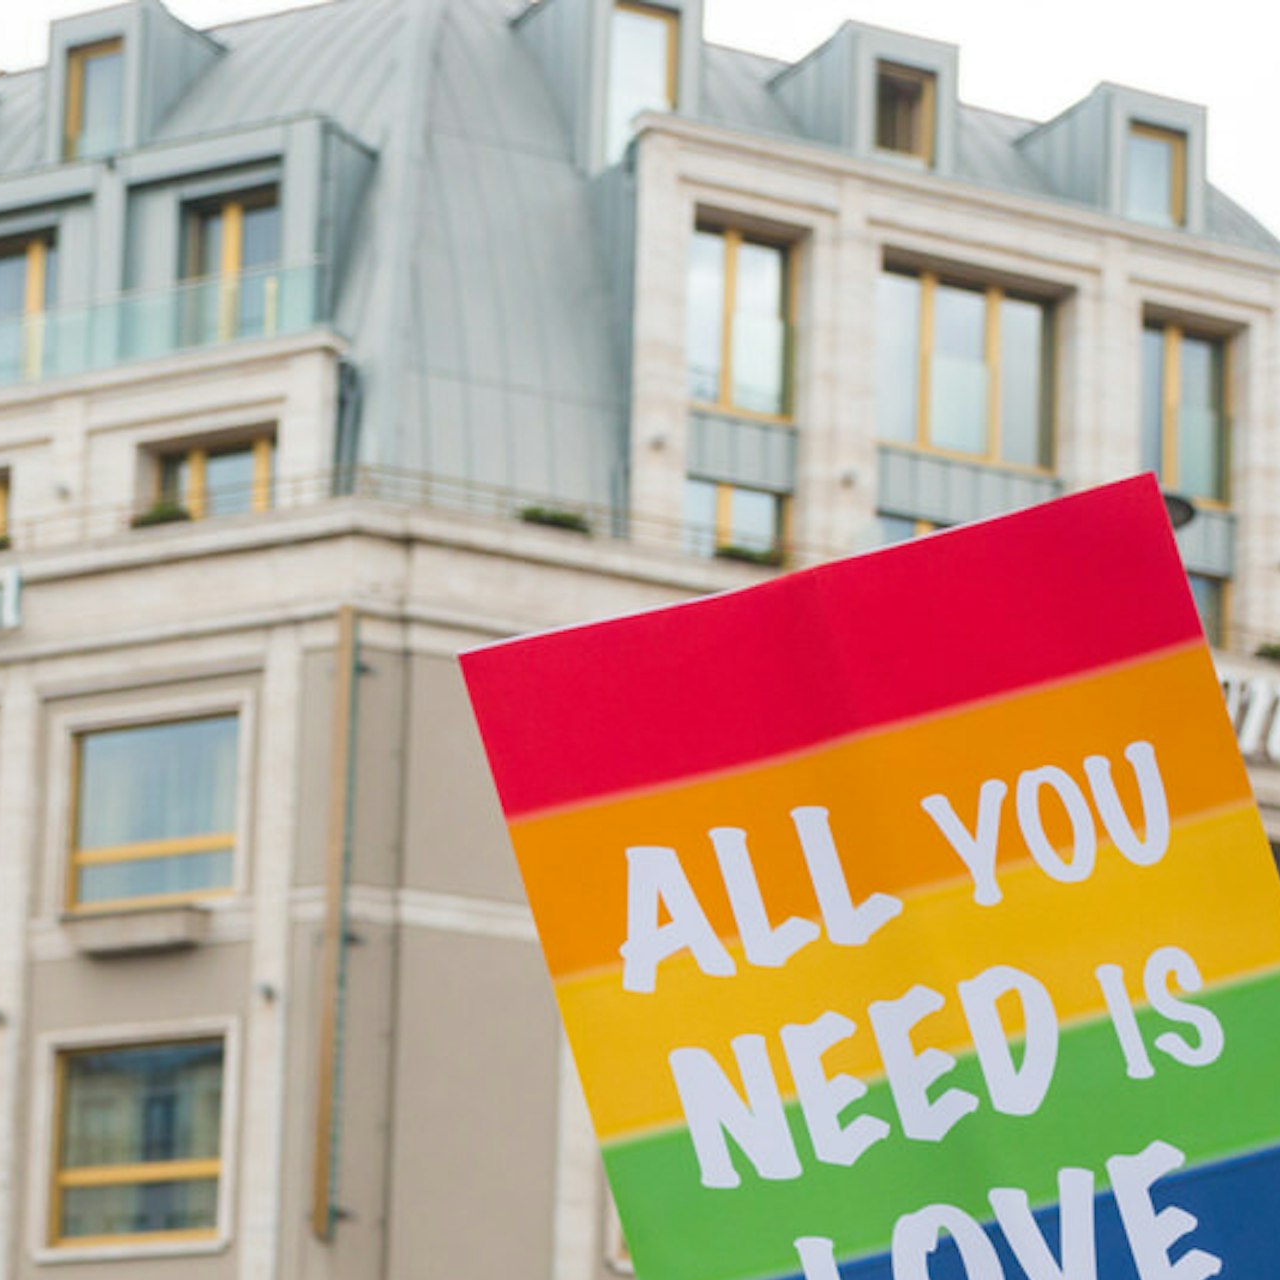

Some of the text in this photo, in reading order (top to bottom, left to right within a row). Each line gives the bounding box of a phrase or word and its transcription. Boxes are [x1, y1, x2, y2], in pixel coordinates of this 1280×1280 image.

[620, 742, 1169, 993] ALL YOU
[669, 947, 1224, 1188] NEED IS
